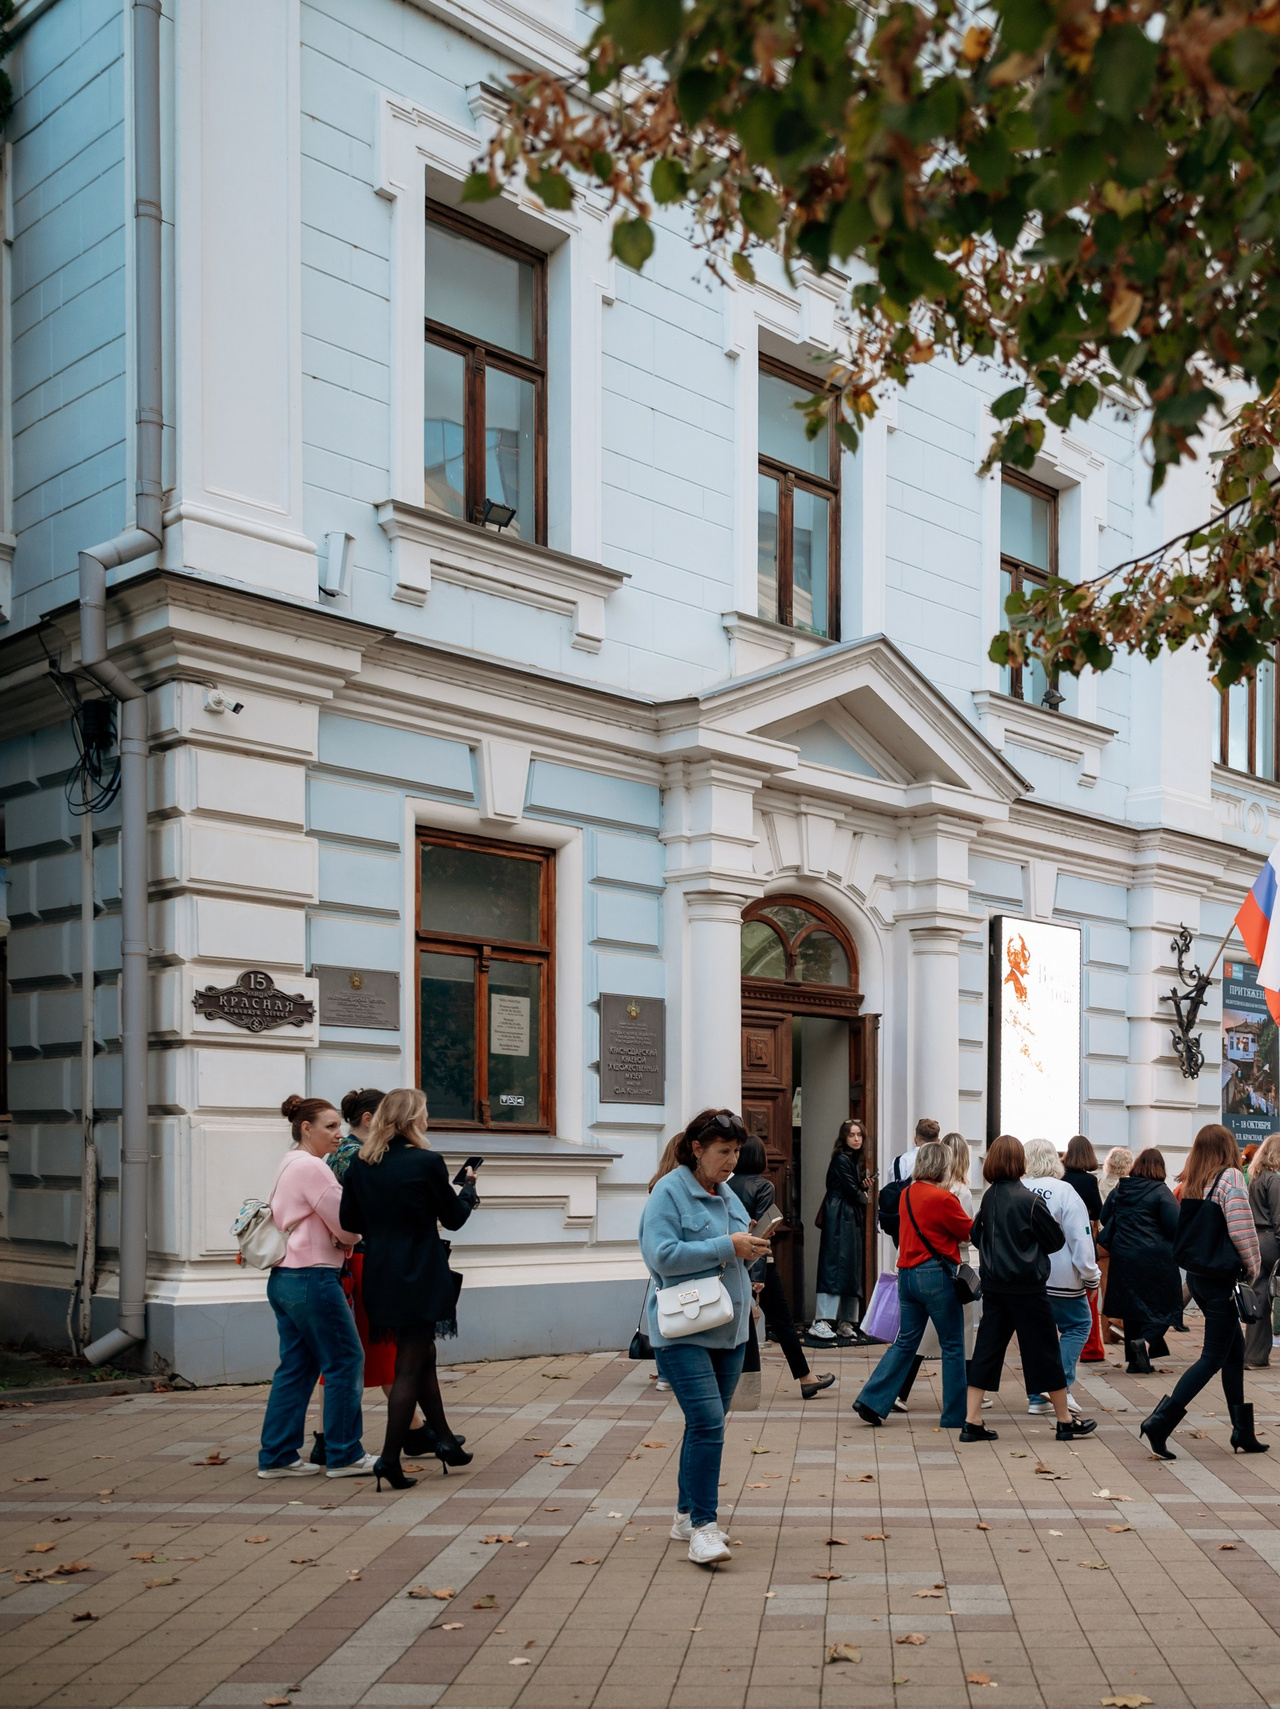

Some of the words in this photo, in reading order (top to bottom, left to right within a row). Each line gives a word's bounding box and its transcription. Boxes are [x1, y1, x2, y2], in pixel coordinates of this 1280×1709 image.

[250, 974, 267, 989] 15
[1230, 985, 1266, 999] ПРИТЯЖЕН
[219, 996, 294, 1012] КРАСНАЯ
[224, 1006, 261, 1016] Krasnaya
[264, 1009, 289, 1018] Street
